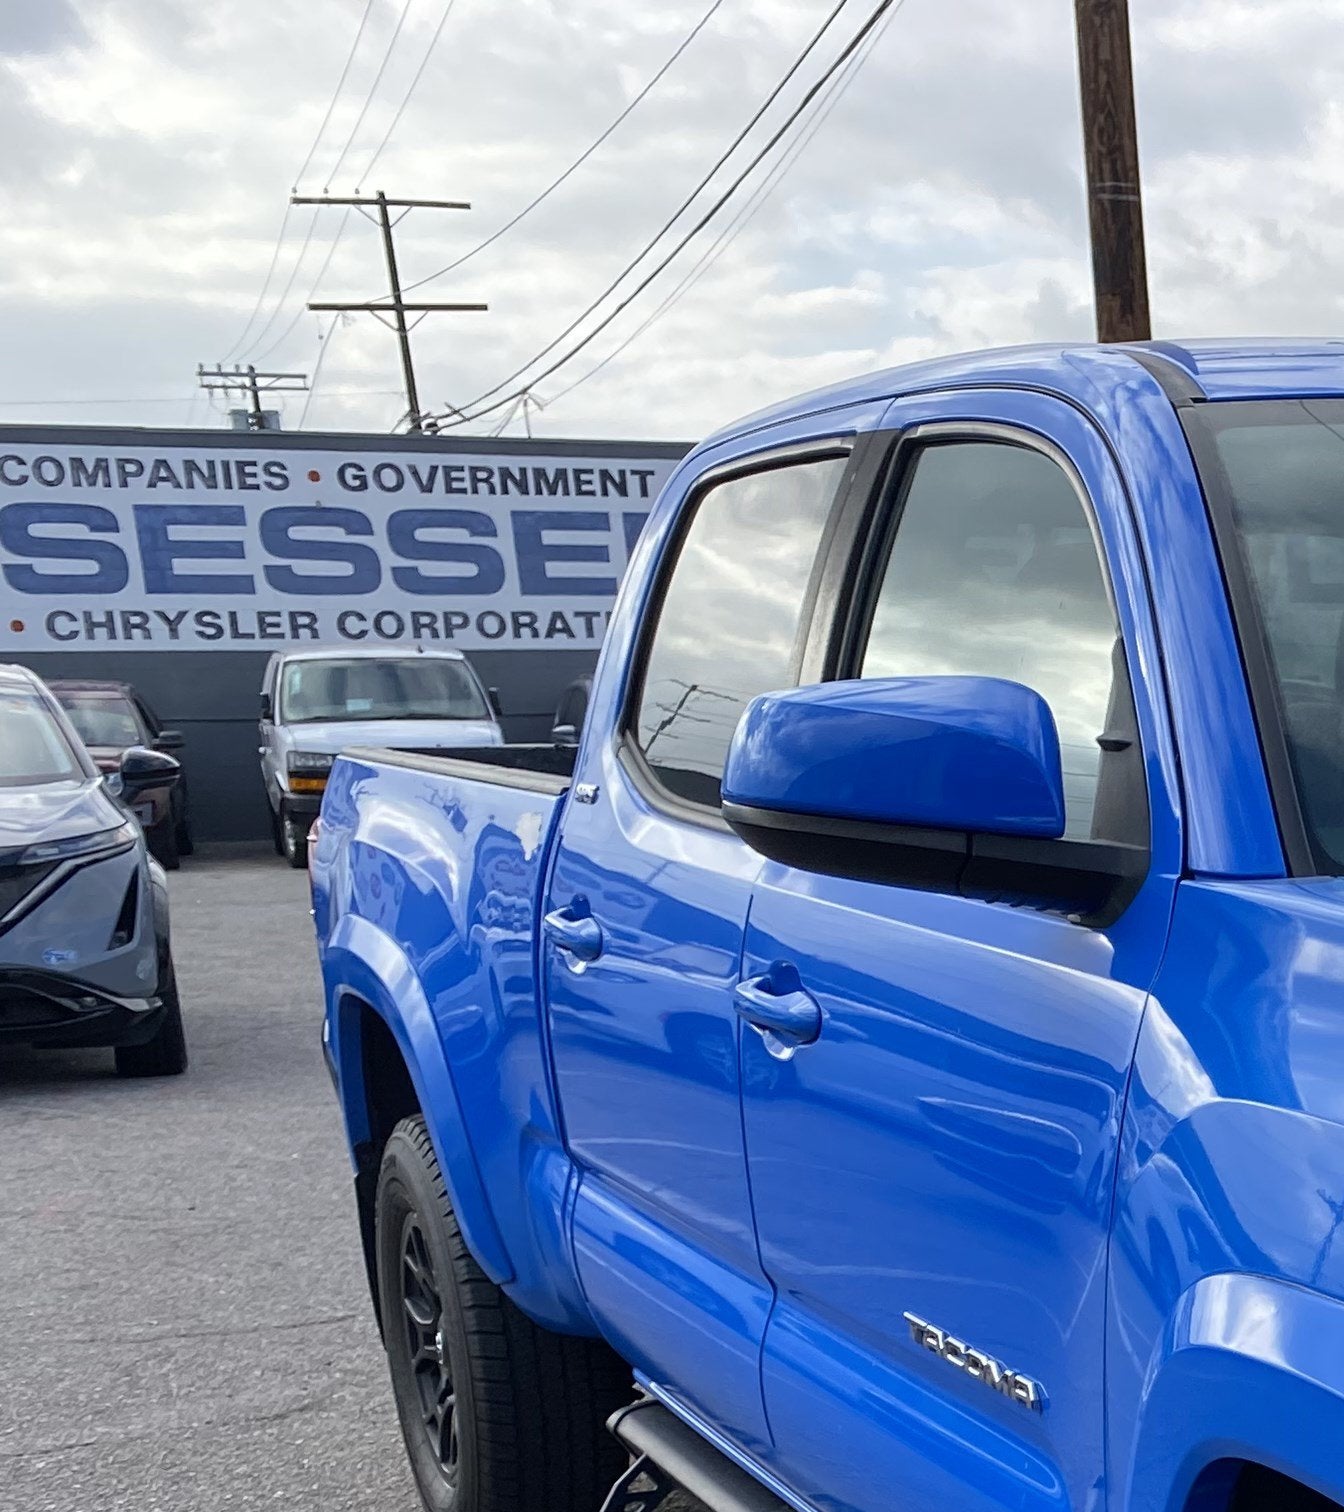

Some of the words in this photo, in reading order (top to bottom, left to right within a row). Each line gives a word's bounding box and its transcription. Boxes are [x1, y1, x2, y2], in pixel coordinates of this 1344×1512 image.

[0, 455, 290, 491] COMPANIES
[336, 462, 656, 498] GOVERNMENT
[45, 609, 320, 641] CHRYSLER
